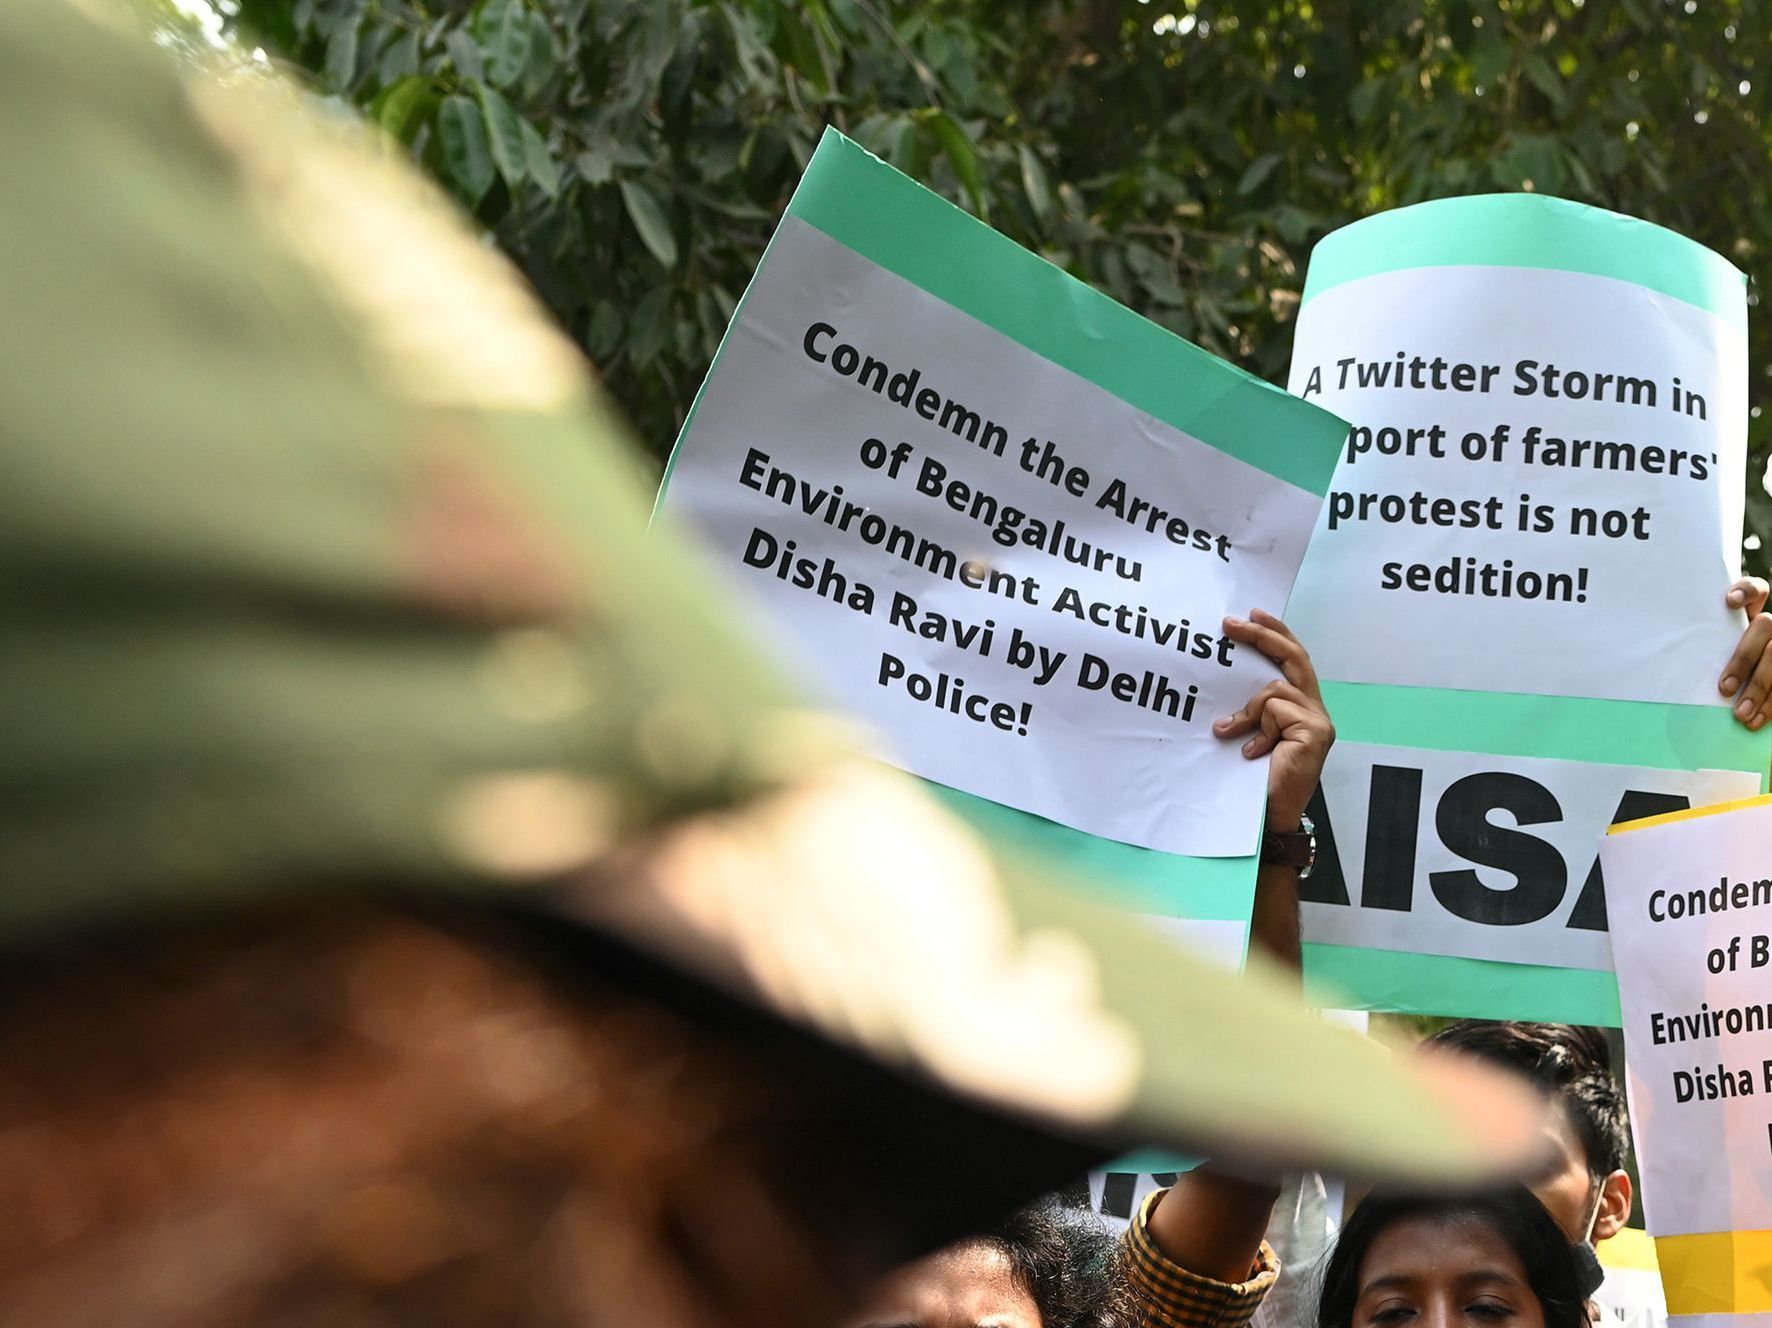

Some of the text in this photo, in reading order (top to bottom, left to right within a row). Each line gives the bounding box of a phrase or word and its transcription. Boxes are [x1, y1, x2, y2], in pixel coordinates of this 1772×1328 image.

[1302, 351, 1707, 421] A Twitter Storm in
[802, 321, 1233, 563] Condemn the Arrest
[1347, 424, 1718, 481] port of farmers'
[859, 437, 1142, 582] of Bengaluru
[1328, 491, 1651, 541] protest is not
[738, 446, 1236, 668] Environment Activist
[1381, 556, 1589, 604] sedition!
[742, 526, 1199, 724] Disha Ravi by Delhi
[878, 652, 1033, 737] Police!
[1707, 936, 1741, 975] of
[1672, 1063, 1754, 1104] Disha
